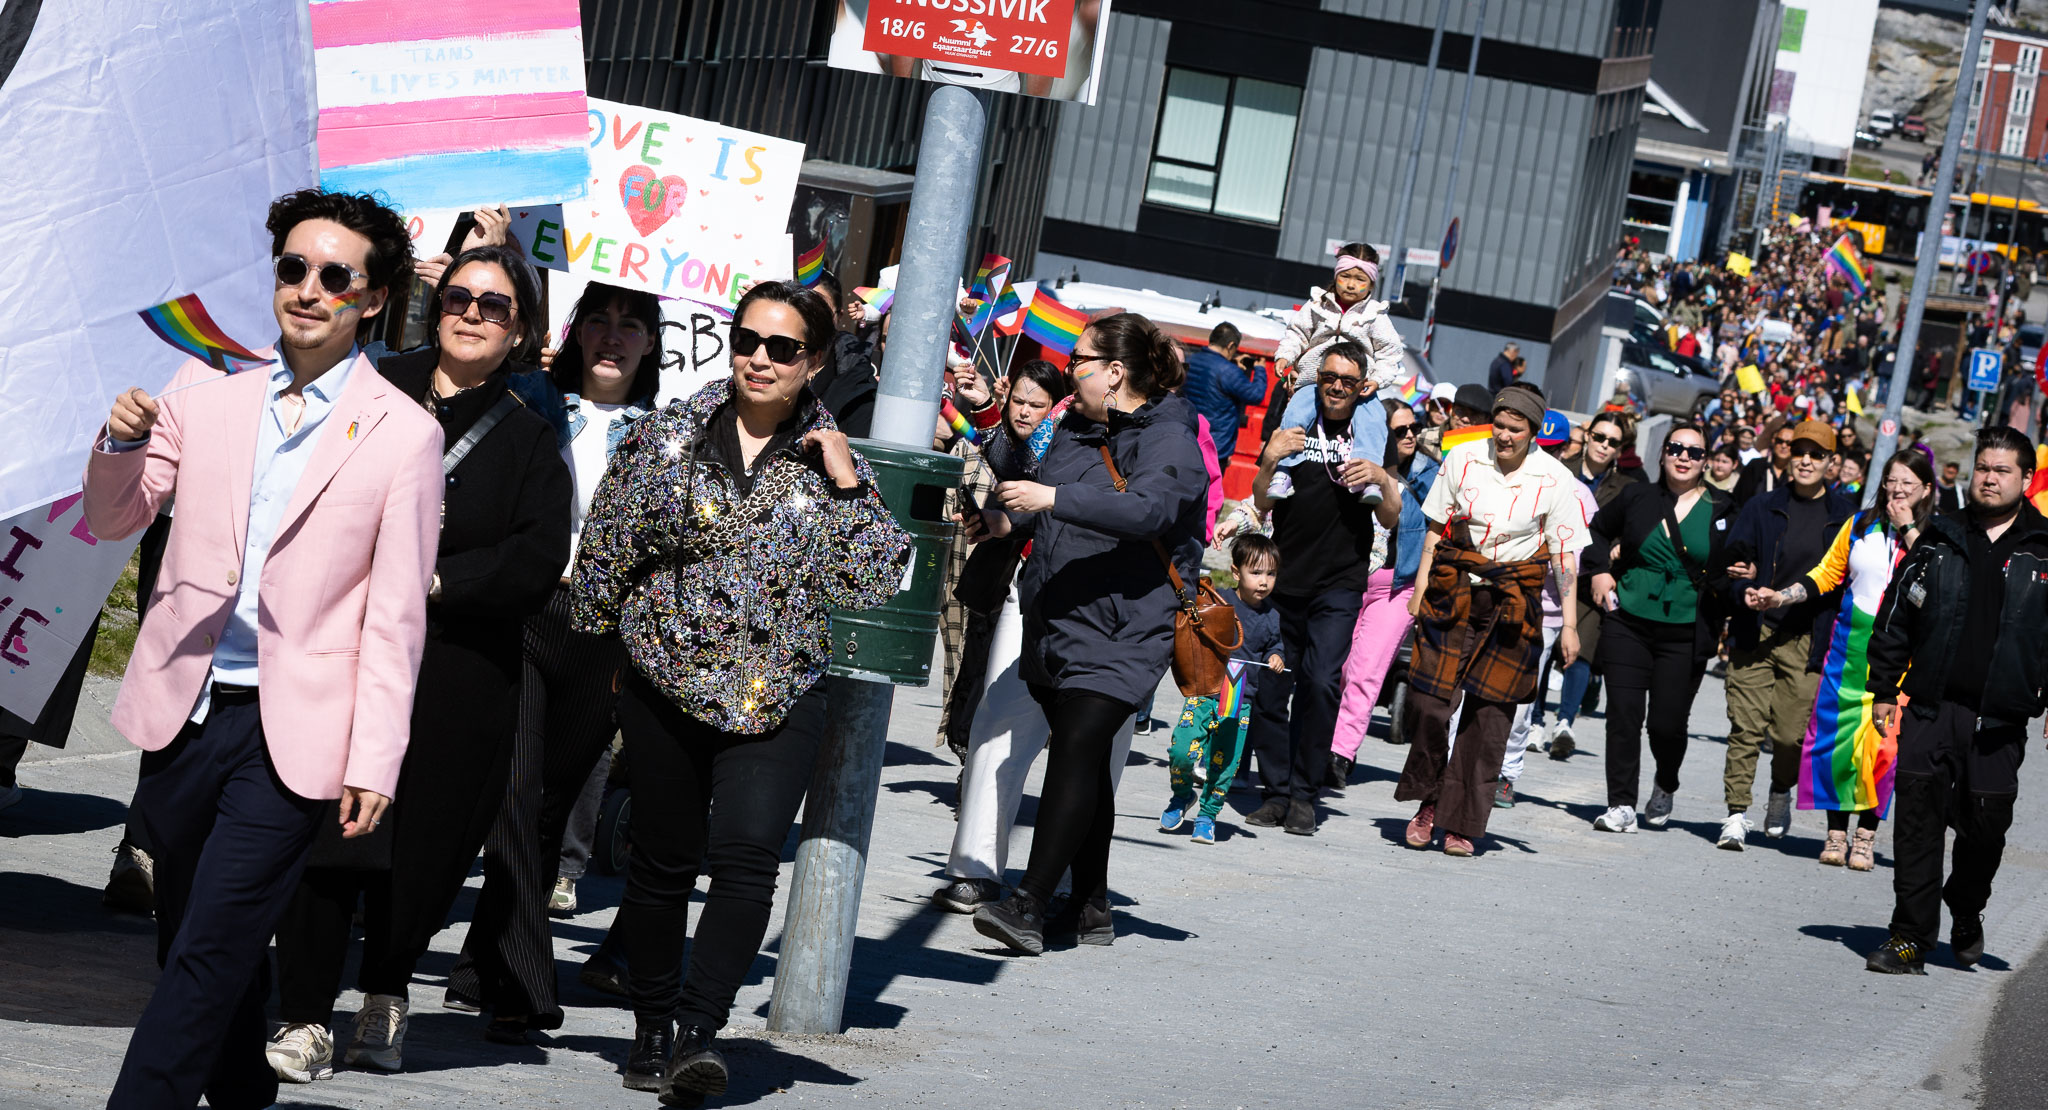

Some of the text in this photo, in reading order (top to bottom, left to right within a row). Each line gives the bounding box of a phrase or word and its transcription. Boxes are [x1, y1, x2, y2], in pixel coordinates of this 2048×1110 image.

[894, 0, 1049, 24] SSIVIK
[880, 17, 926, 40] 18/6
[938, 35, 972, 47] Nuummi
[1009, 35, 1058, 58] 27/6
[405, 44, 474, 64] TRANS
[370, 65, 571, 96] LIVES MATTER
[588, 108, 767, 186] OVE IS
[622, 174, 688, 218] FOR
[532, 219, 750, 305] EVERYONE
[1975, 353, 1998, 378] P
[1543, 422, 1555, 436] U
